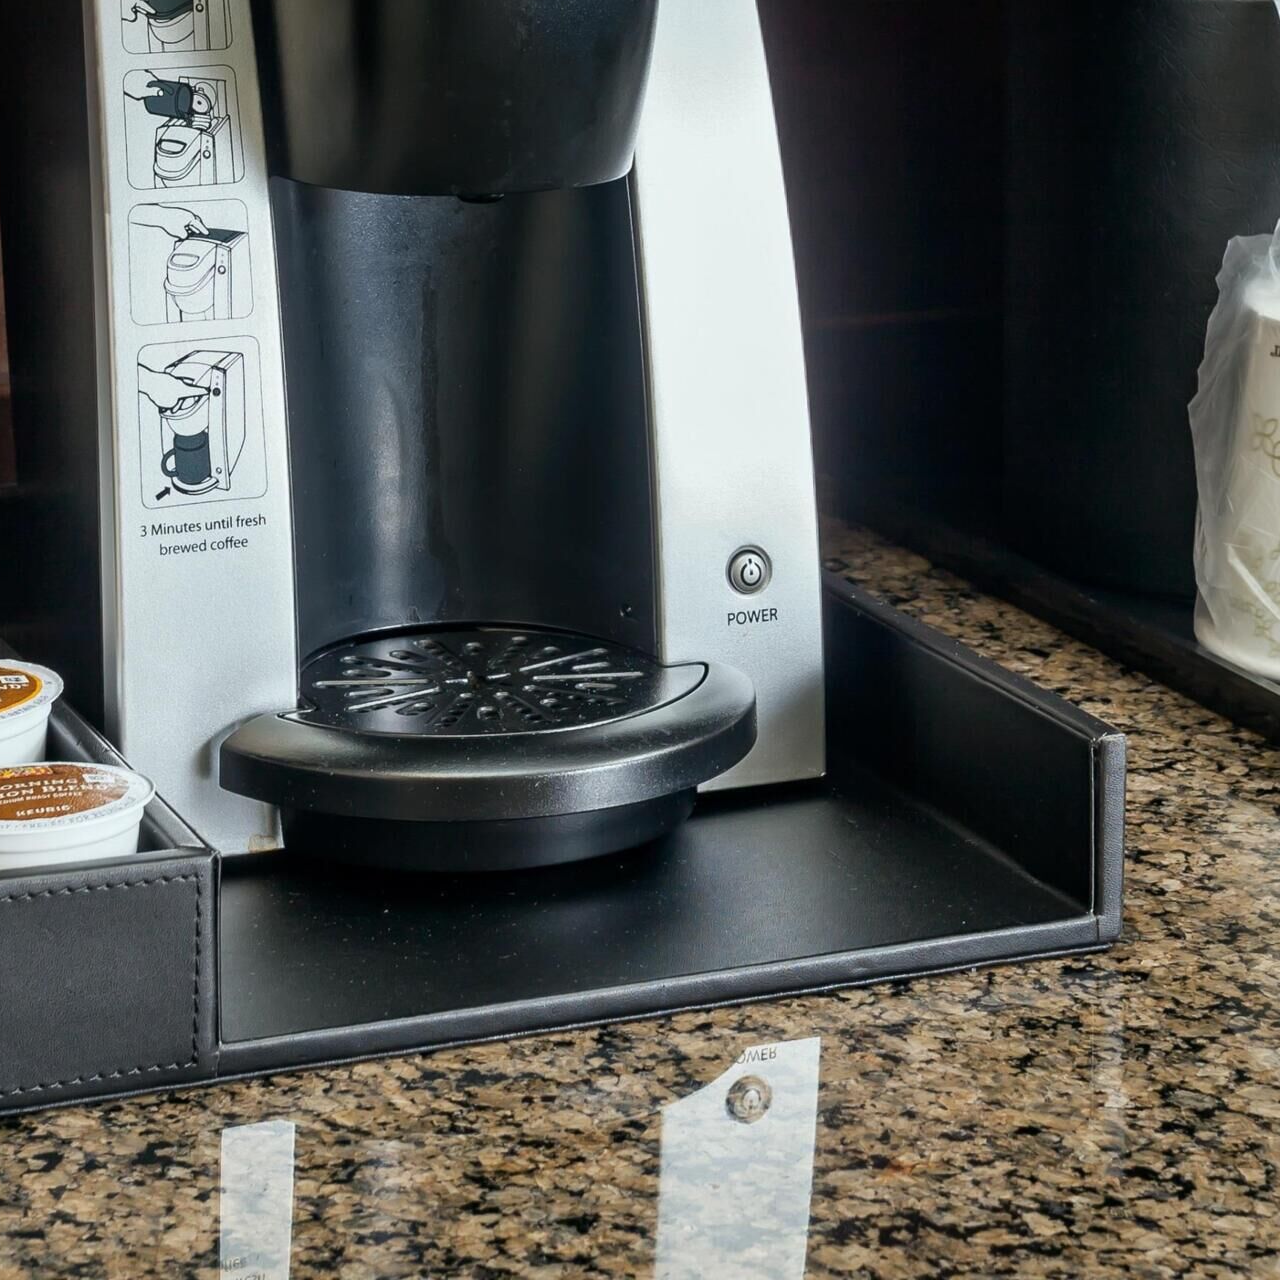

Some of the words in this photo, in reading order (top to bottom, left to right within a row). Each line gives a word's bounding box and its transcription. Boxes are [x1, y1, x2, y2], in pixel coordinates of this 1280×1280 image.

[140, 525, 148, 537] 3
[151, 521, 202, 536] Minutes
[205, 515, 233, 531] until
[236, 513, 267, 528] fresh
[159, 539, 207, 556] brewed
[210, 535, 249, 550] coffee
[727, 607, 778, 626] POWER
[26, 793, 51, 801] ROAST
[52, 791, 83, 799] COFFEE
[42, 783, 108, 793] BLEND
[15, 804, 71, 817] KEURIG
